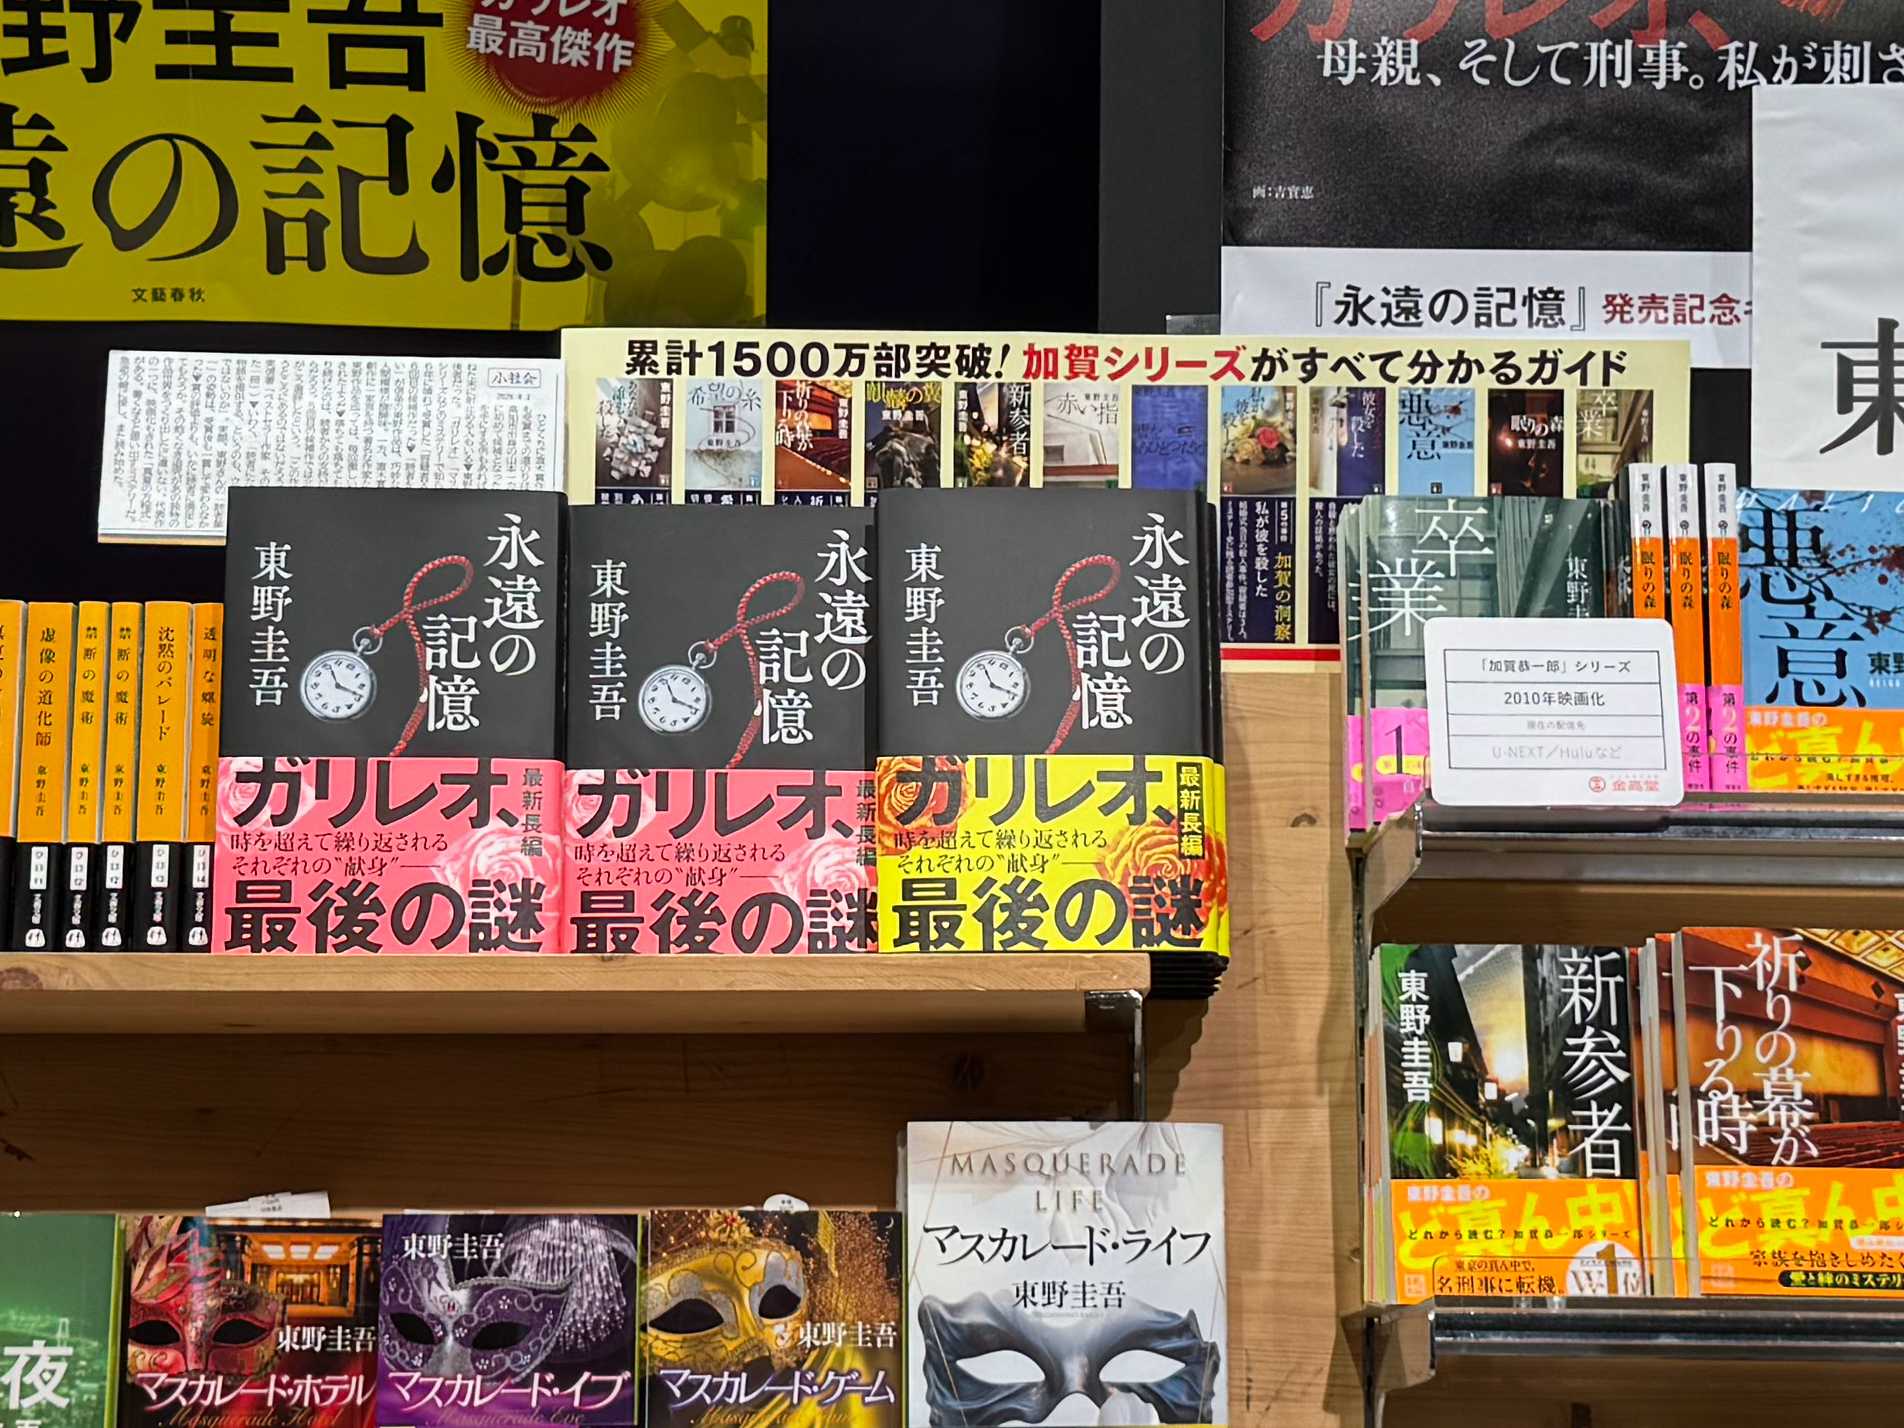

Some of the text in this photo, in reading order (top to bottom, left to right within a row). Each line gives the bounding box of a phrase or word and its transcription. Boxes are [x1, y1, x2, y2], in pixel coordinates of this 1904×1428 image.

[466, 13, 638, 75] 最高傑作
[1314, 282, 1587, 333] 『永遠の記憶』
[625, 339, 1628, 389] 累計1500万部突破! 加賀シリーズがすべて分かるガイド
[1254, 501, 1269, 598] 私が彼を殺した
[1368, 499, 1495, 639] 卒業
[248, 541, 291, 708] 東野圭吾
[483, 513, 545, 678] 永遠の
[903, 542, 945, 707] 東野圭吾
[1273, 551, 1294, 643] 加賀の洞察
[1740, 499, 1869, 710] 悪意
[421, 614, 480, 732] 記憶
[588, 559, 628, 722] 東野圭吾
[35, 627, 57, 747] 虚像の道化師
[156, 626, 176, 742] 沈黙のパレード
[1503, 690, 1606, 708] 2010年映画化
[1612, 776, 1660, 794] 金高堂
[228, 828, 449, 855] 時を超えて繰り返される
[224, 876, 545, 954] 最後の謎
[570, 889, 878, 955] 最後の謎
[893, 876, 1205, 951] 最後の謎
[1558, 947, 1633, 1179] 新参者
[1693, 965, 1759, 1157] 下りる時
[1751, 930, 1820, 1166] 祈りの幕が
[949, 1150, 1189, 1177] MASQUERADE
[1033, 1189, 1106, 1215] LIFE
[922, 1222, 1212, 1268] マスカレード・ライフ
[138, 1369, 378, 1412] マスカレード・ホテル
[388, 1371, 635, 1412] マスカレード・イブ
[657, 1368, 896, 1410] マスカレード・ゲーム
